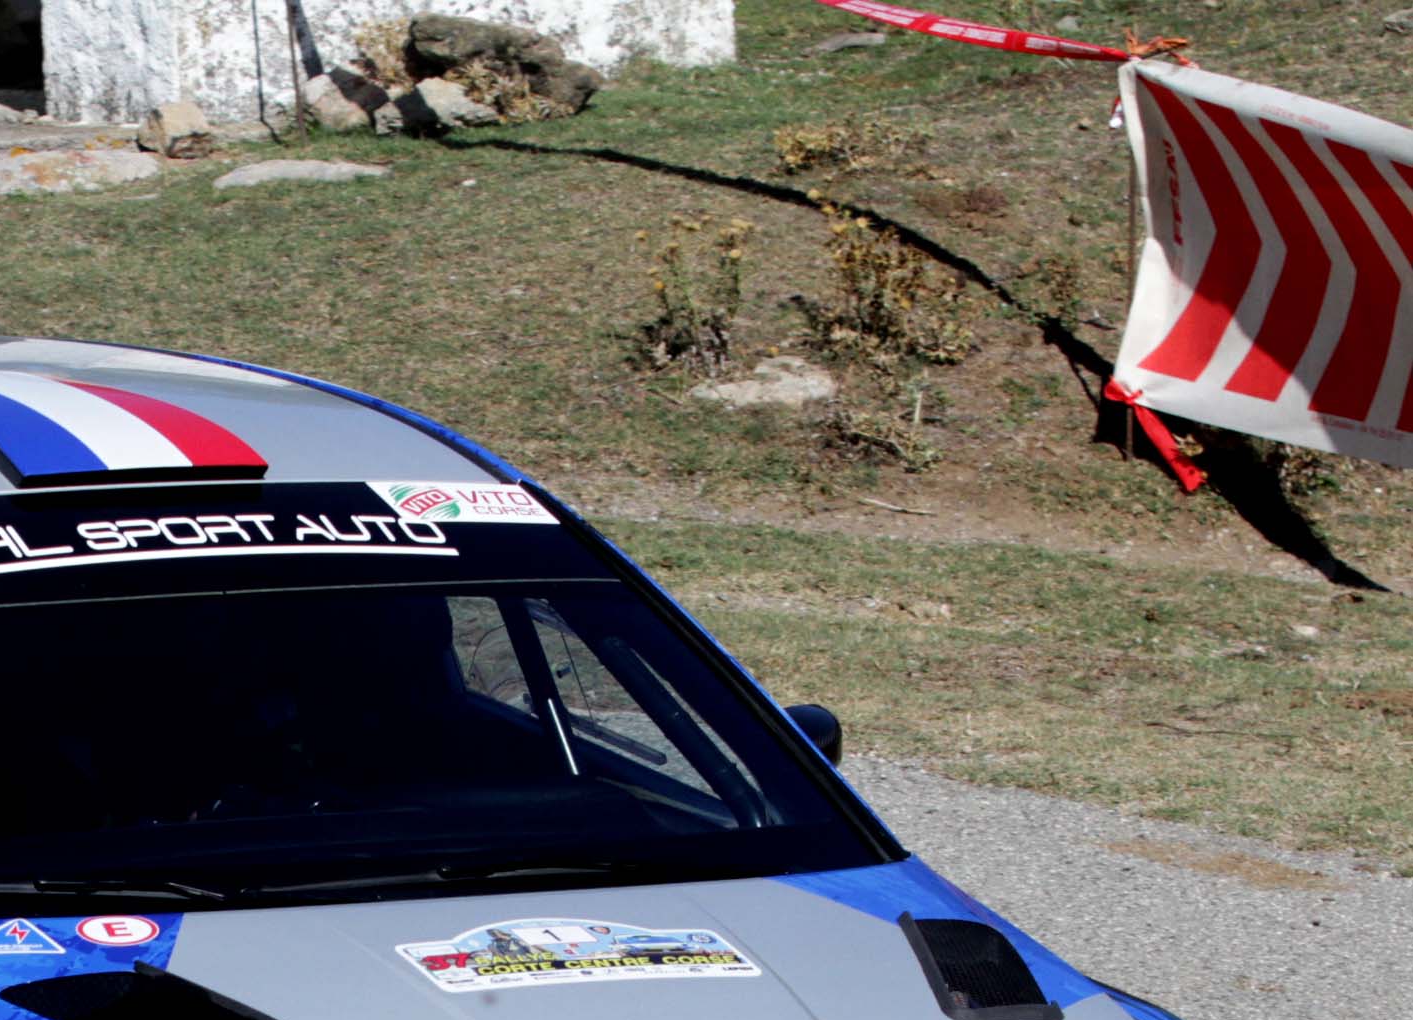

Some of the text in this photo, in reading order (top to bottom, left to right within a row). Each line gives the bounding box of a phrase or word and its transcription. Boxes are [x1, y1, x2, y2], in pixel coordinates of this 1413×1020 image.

[403, 491, 447, 514] VITO
[473, 505, 546, 516] CORSE
[77, 514, 275, 550] SPORT
[296, 514, 447, 544] AUTO
[102, 921, 133, 938] E
[543, 929, 562, 941] 1
[474, 952, 555, 965] RALLYE
[477, 961, 554, 976] CORTE
[564, 956, 653, 971] CENTRE
[661, 954, 737, 966] CORSE
